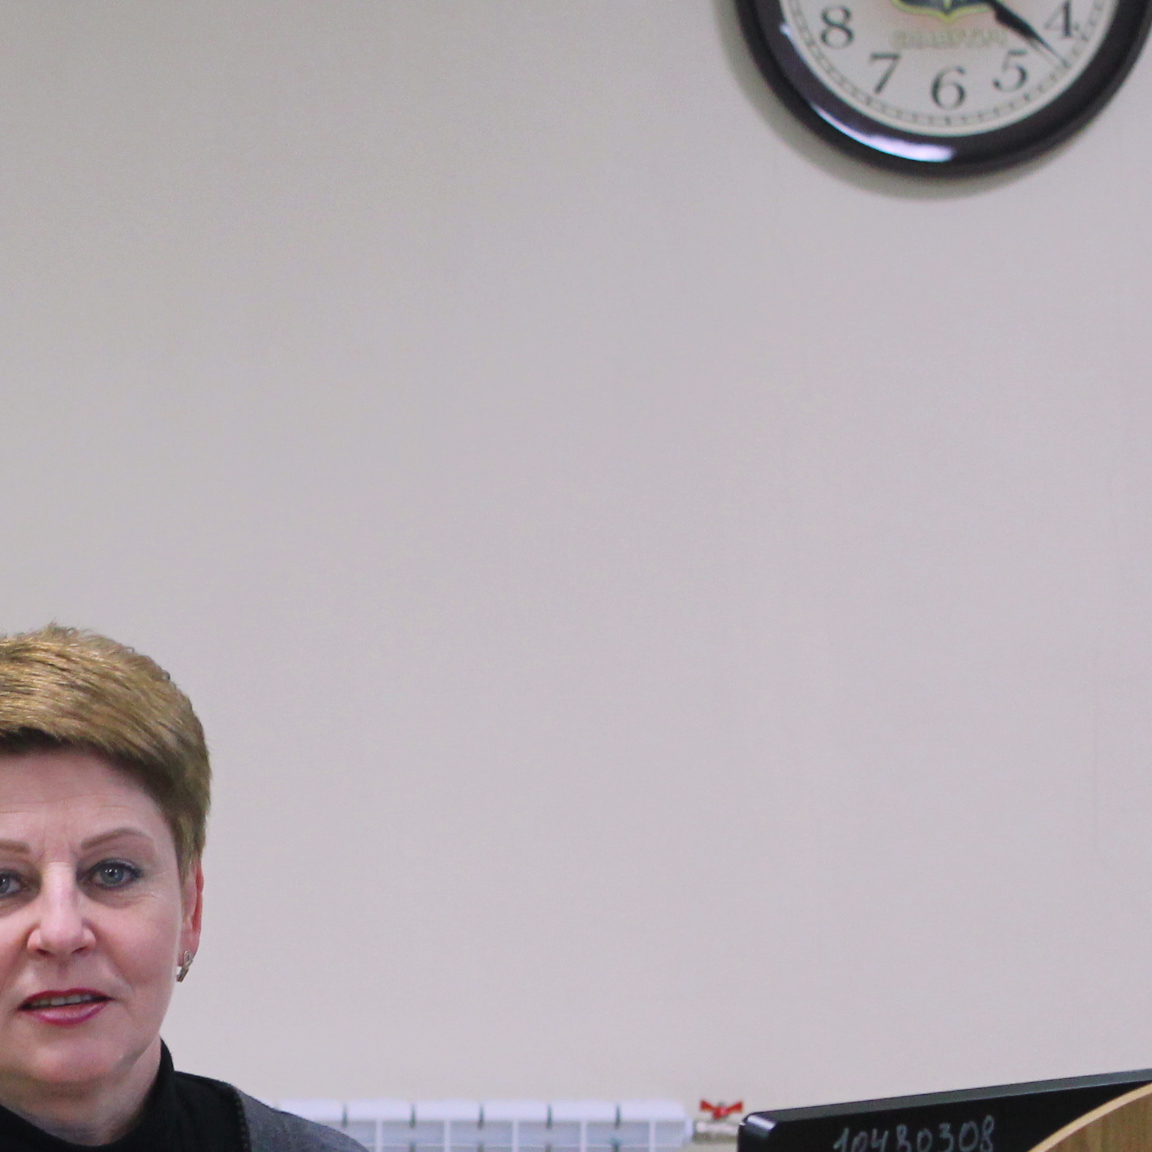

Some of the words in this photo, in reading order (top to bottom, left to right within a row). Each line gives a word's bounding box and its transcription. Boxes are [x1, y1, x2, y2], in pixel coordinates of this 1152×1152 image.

[820, 3, 855, 49] 8
[1043, 0, 1073, 38] 4
[869, 52, 902, 95] 7
[931, 65, 966, 110] 6
[993, 50, 1029, 92] 5
